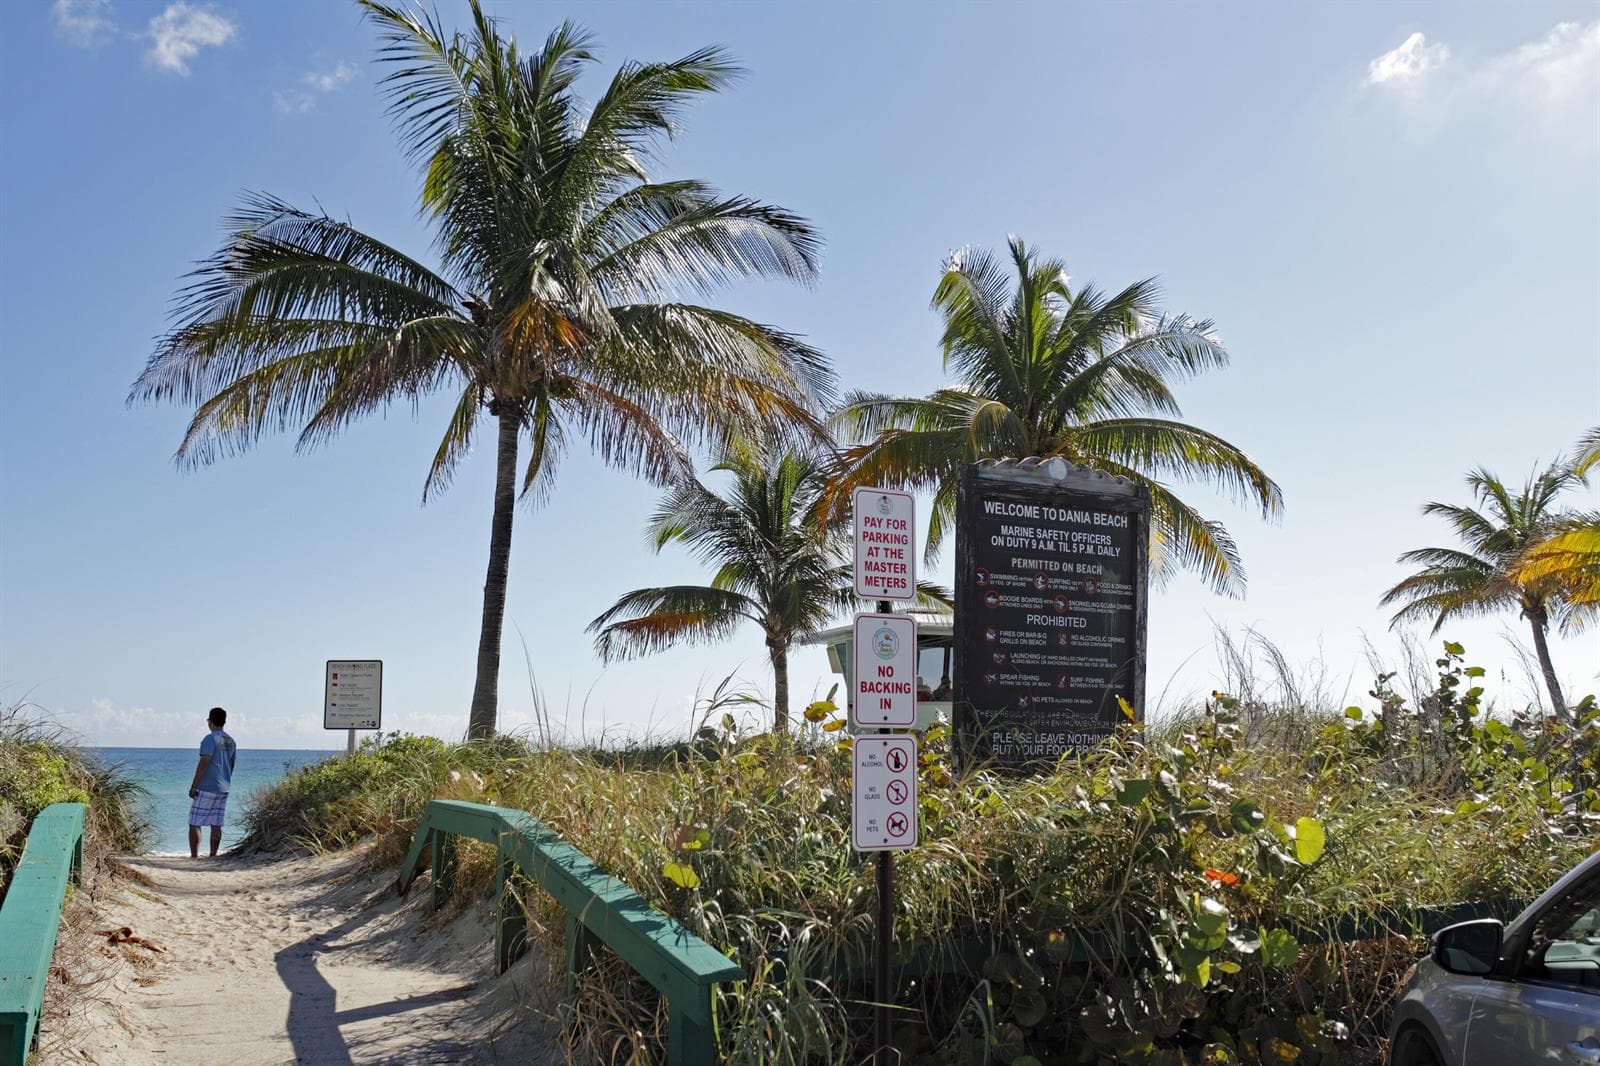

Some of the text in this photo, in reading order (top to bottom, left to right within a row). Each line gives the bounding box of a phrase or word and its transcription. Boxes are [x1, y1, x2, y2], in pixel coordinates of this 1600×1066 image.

[984, 500, 1128, 529] WELCOME TO DANIA BEACH
[864, 516, 907, 531] PAY FOR
[862, 530, 908, 546] PARKING
[1001, 525, 1112, 546] MARINE SAFETY OFFICERS
[991, 535, 1121, 557] ON DUTY 9 A.M. TIL 5 P.M. DAILY
[867, 546, 904, 560] AT THE
[864, 560, 907, 575] MASTER
[1011, 557, 1102, 575] PERMITTED ON BEACH
[864, 575, 907, 589] METERS
[998, 594, 1021, 603] BOOGIE
[1021, 596, 1043, 604] BOARDS
[1026, 614, 1088, 629] PROHIBITED
[999, 630, 1016, 638] FIRES
[1080, 635, 1107, 643] ALCOHOLIC
[999, 637, 1019, 645] GRILLS
[1029, 638, 1047, 646] BEACH
[1009, 652, 1041, 660] LAUNCHING
[877, 665, 894, 678] NO
[999, 673, 1040, 682] SPEAR FISHING
[860, 681, 910, 694] BACKING
[880, 697, 892, 710] IN
[1041, 696, 1054, 704] PETS
[992, 732, 1033, 744] PLESE
[1034, 732, 1065, 745] LEAVE
[992, 744, 1013, 755] BUT
